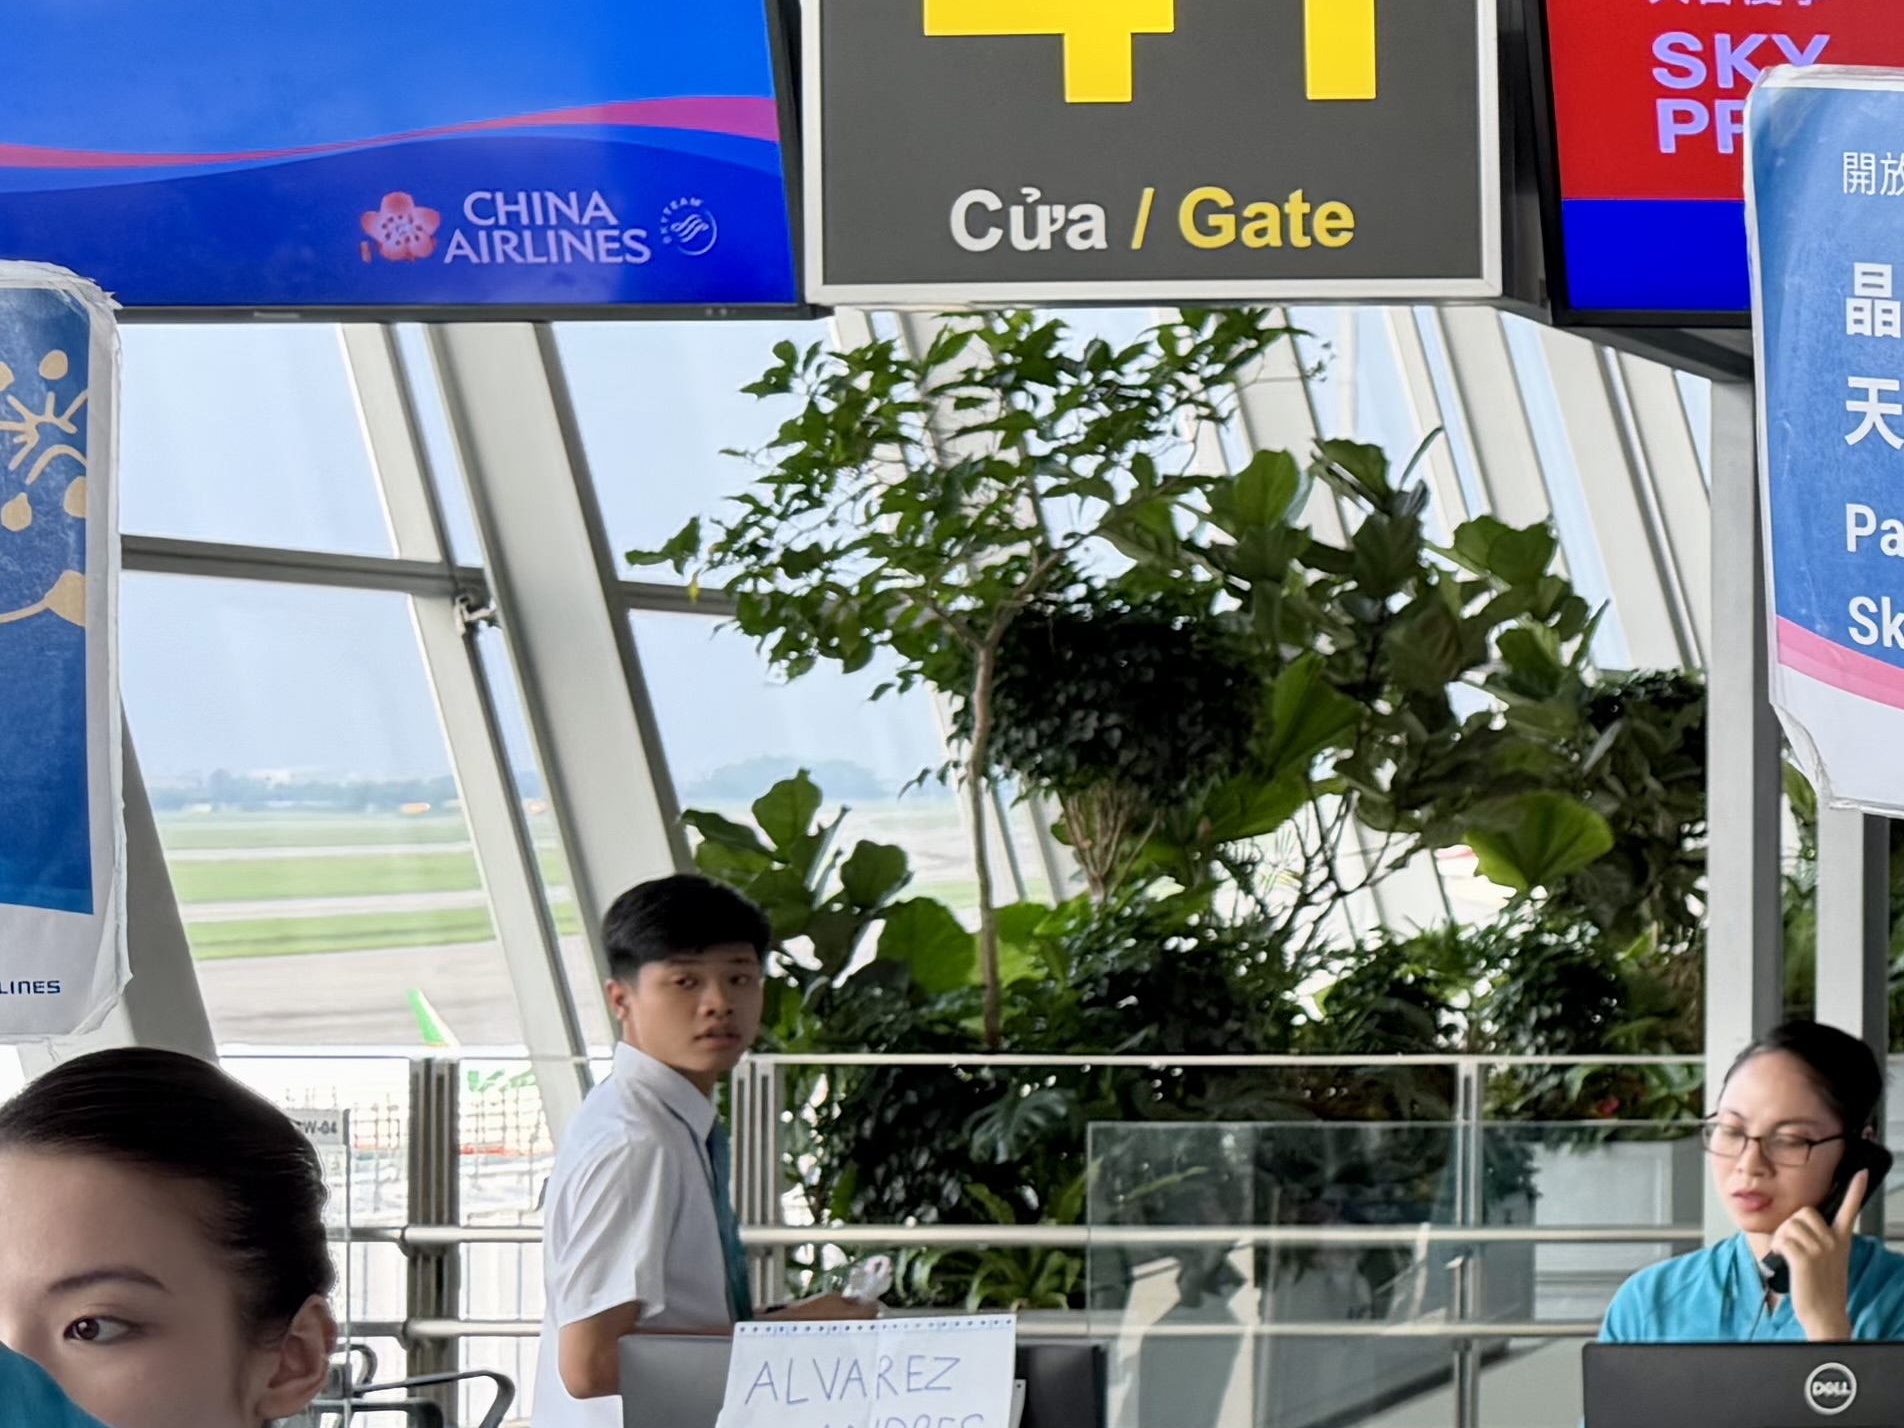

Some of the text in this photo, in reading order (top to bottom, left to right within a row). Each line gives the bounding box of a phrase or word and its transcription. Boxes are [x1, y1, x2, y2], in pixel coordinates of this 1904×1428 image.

[1652, 31, 1831, 89] SKY
[464, 191, 617, 226] CHINA
[949, 186, 1356, 253] Cửa / Gate
[444, 228, 651, 265] AIRLINES
[745, 1353, 964, 1407] ALVAREZ
[1812, 1381, 1851, 1397] DELL
